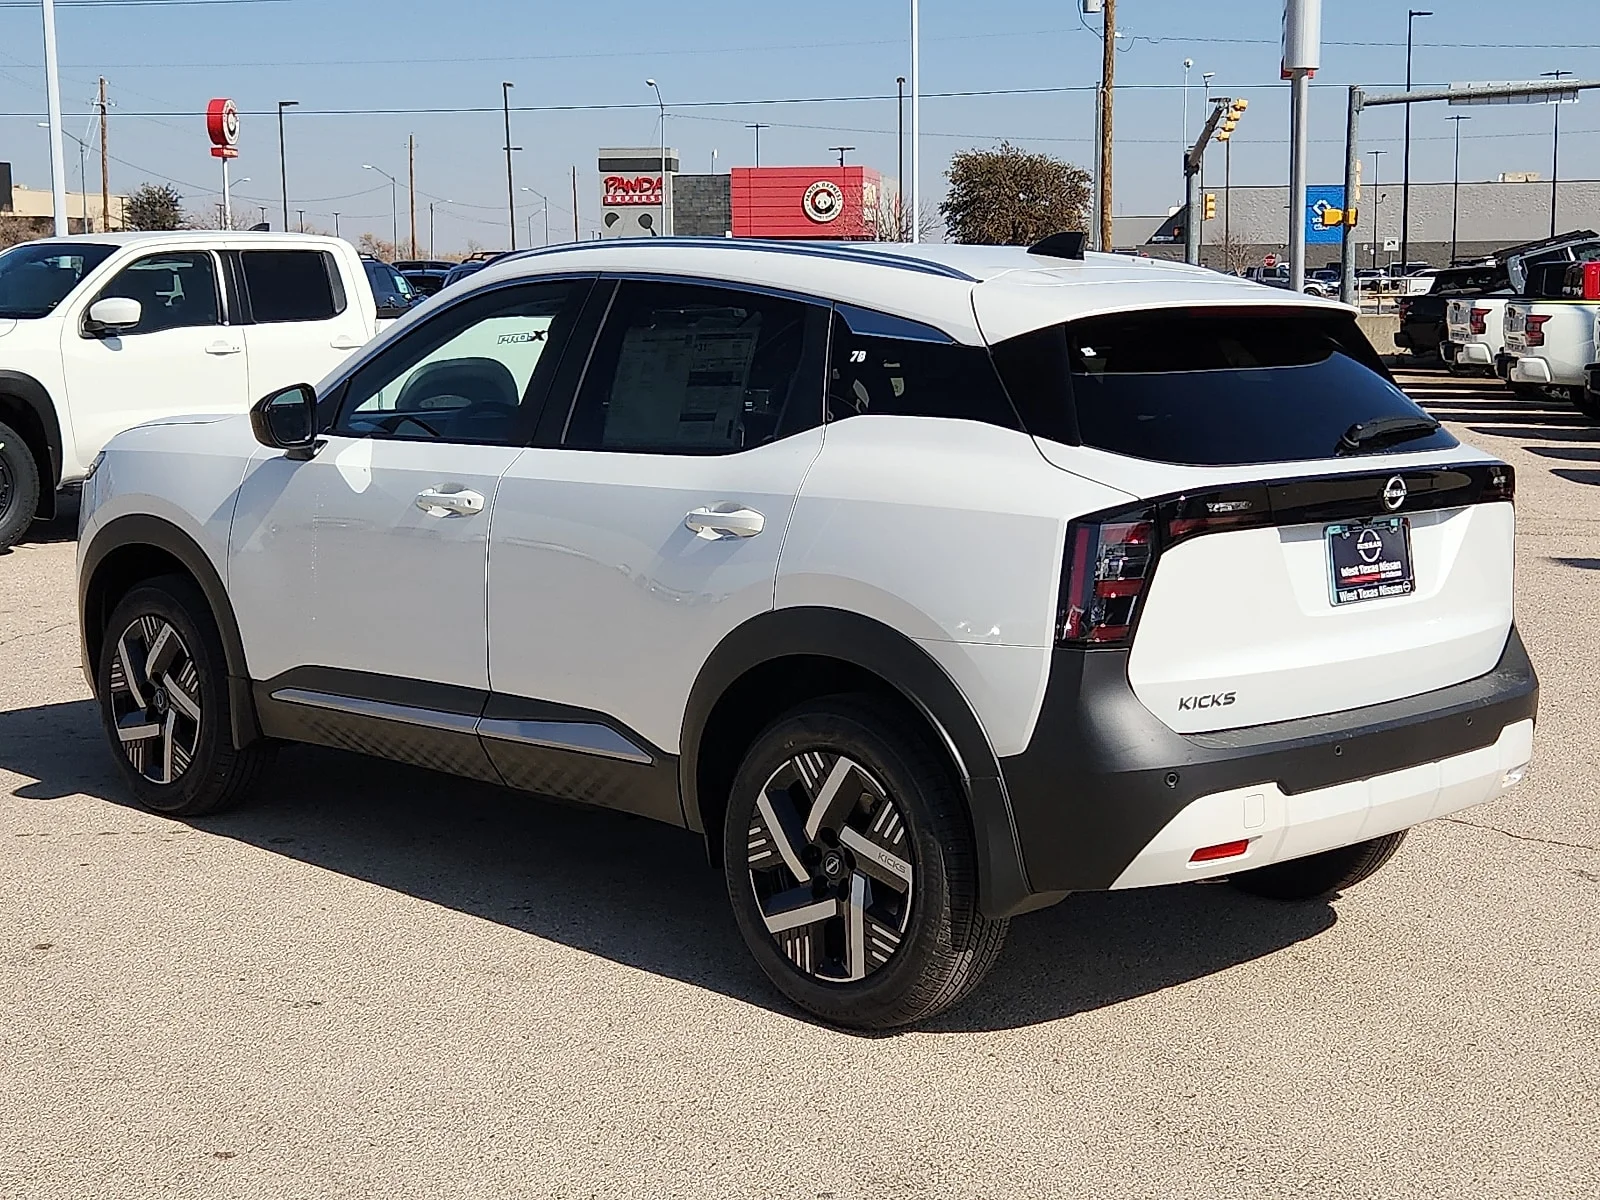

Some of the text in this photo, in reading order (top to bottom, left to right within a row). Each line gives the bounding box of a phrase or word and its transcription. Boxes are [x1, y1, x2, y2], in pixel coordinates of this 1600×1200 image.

[603, 176, 663, 195] PANDA
[1341, 566, 1360, 577] West
[1359, 564, 1379, 574] Texas
[1379, 561, 1402, 571] Nissan
[1339, 585, 1403, 601] West Texas Nissan
[1178, 691, 1237, 712] KICKS
[877, 852, 906, 874] KICKS
